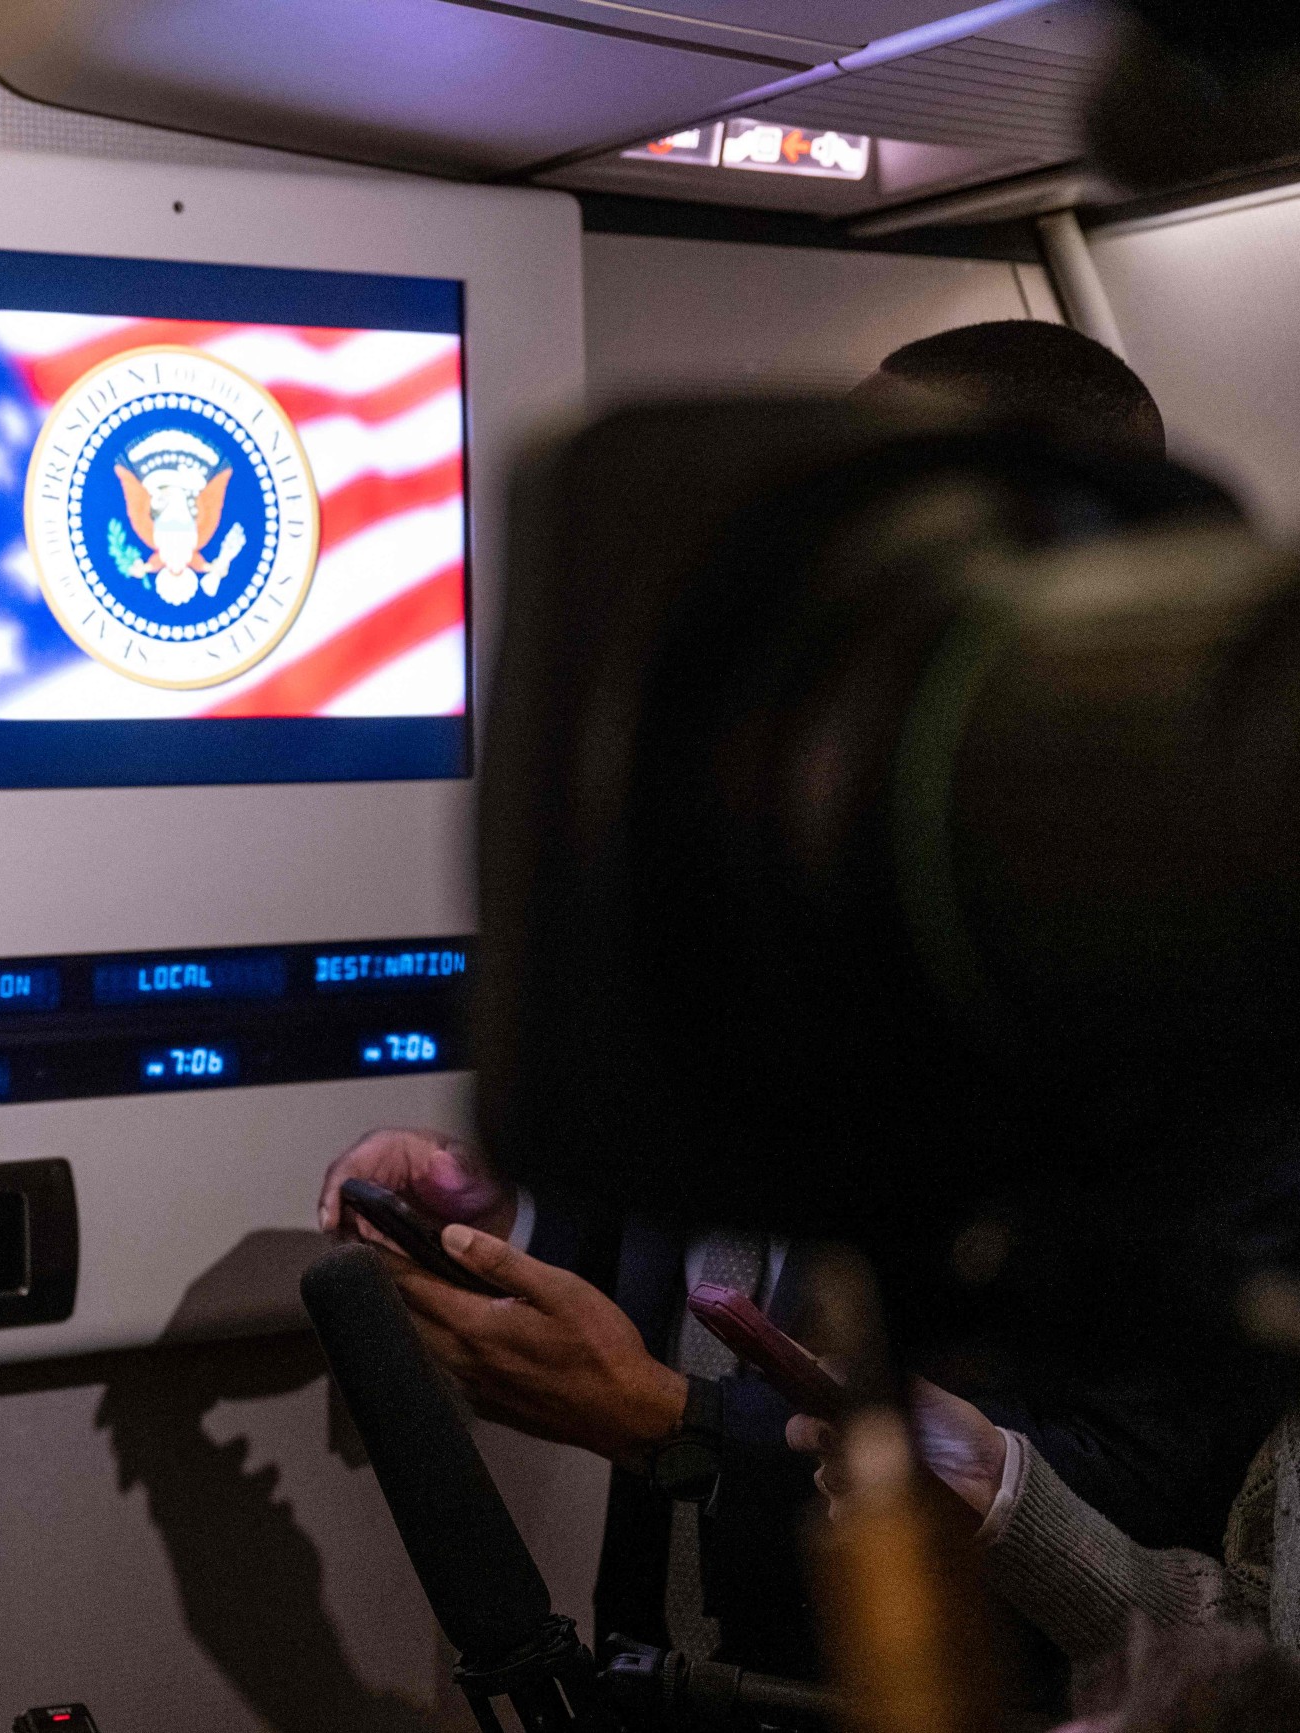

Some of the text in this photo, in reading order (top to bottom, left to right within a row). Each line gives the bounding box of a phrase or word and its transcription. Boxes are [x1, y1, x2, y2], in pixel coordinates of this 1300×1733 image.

[138, 964, 213, 991] LOCAL
[315, 951, 466, 982] DESTINATION
[386, 1033, 437, 1061] 7:06
[170, 1048, 224, 1076] 7:06
